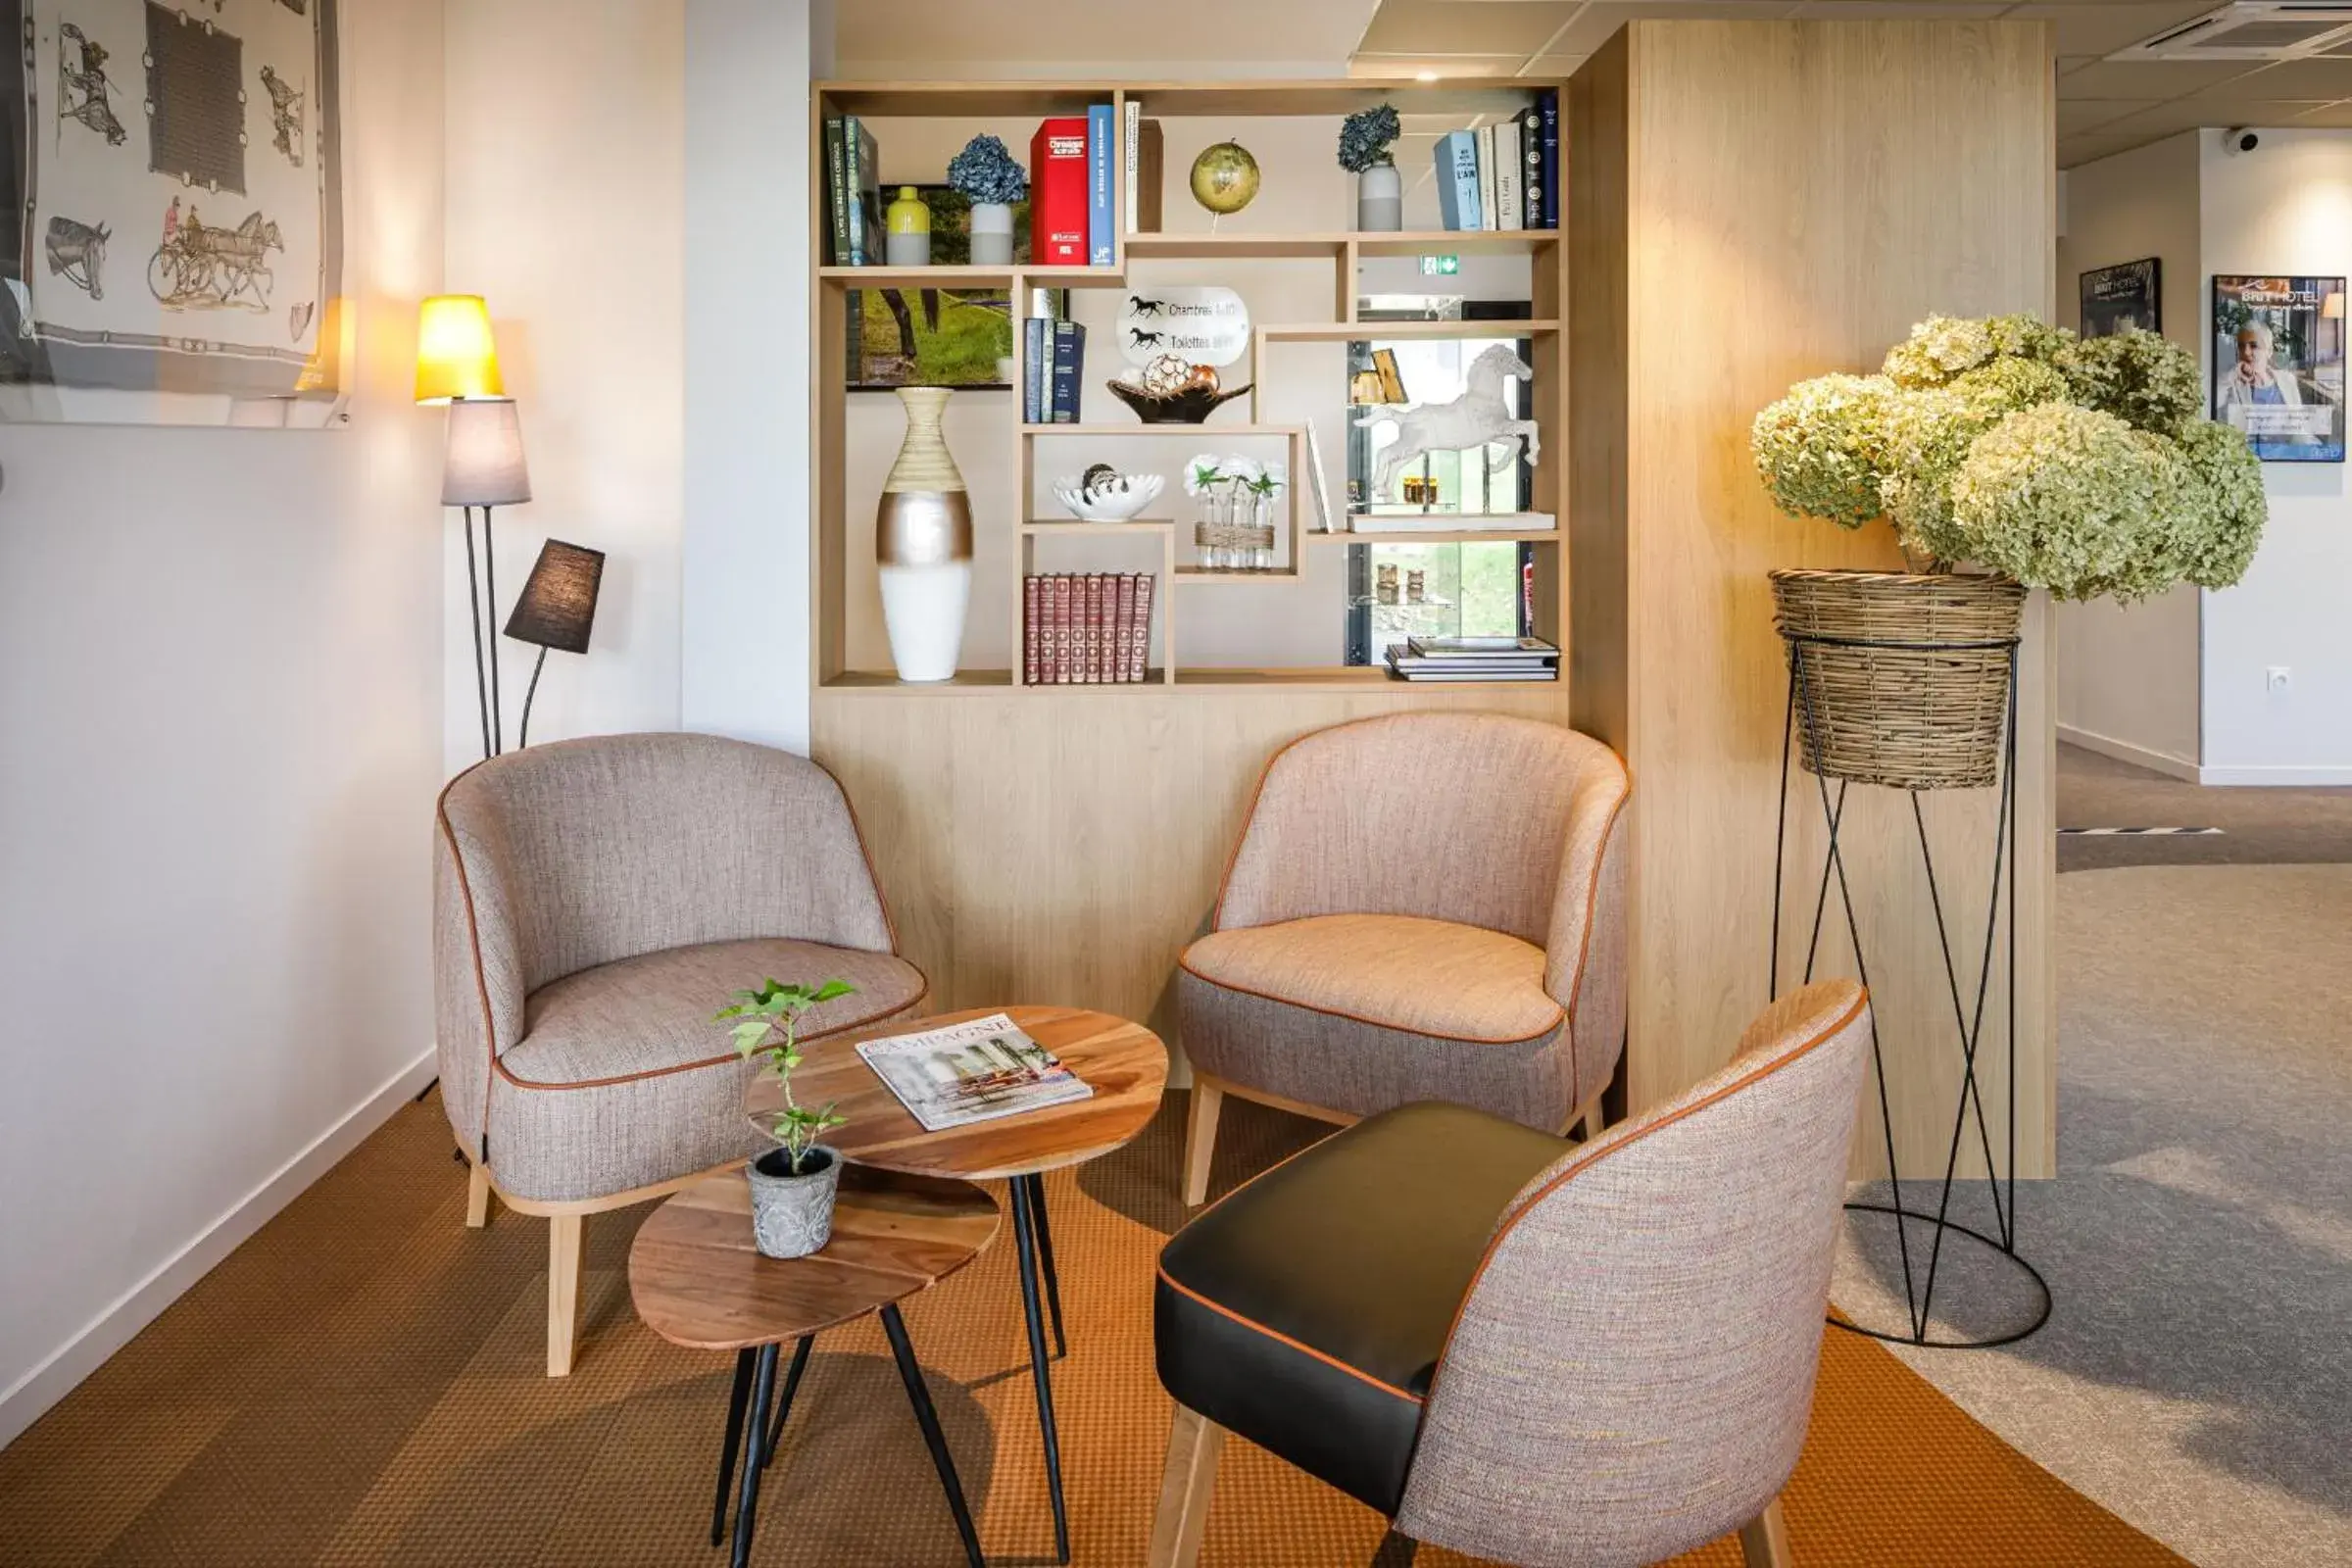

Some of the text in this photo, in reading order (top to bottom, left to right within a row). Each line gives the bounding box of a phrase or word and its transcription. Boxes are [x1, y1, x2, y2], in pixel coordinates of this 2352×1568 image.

[2241, 290, 2319, 303] BRIT HOTEL
[1169, 303, 1212, 317] Chambres
[1171, 334, 1210, 349] Toilettes
